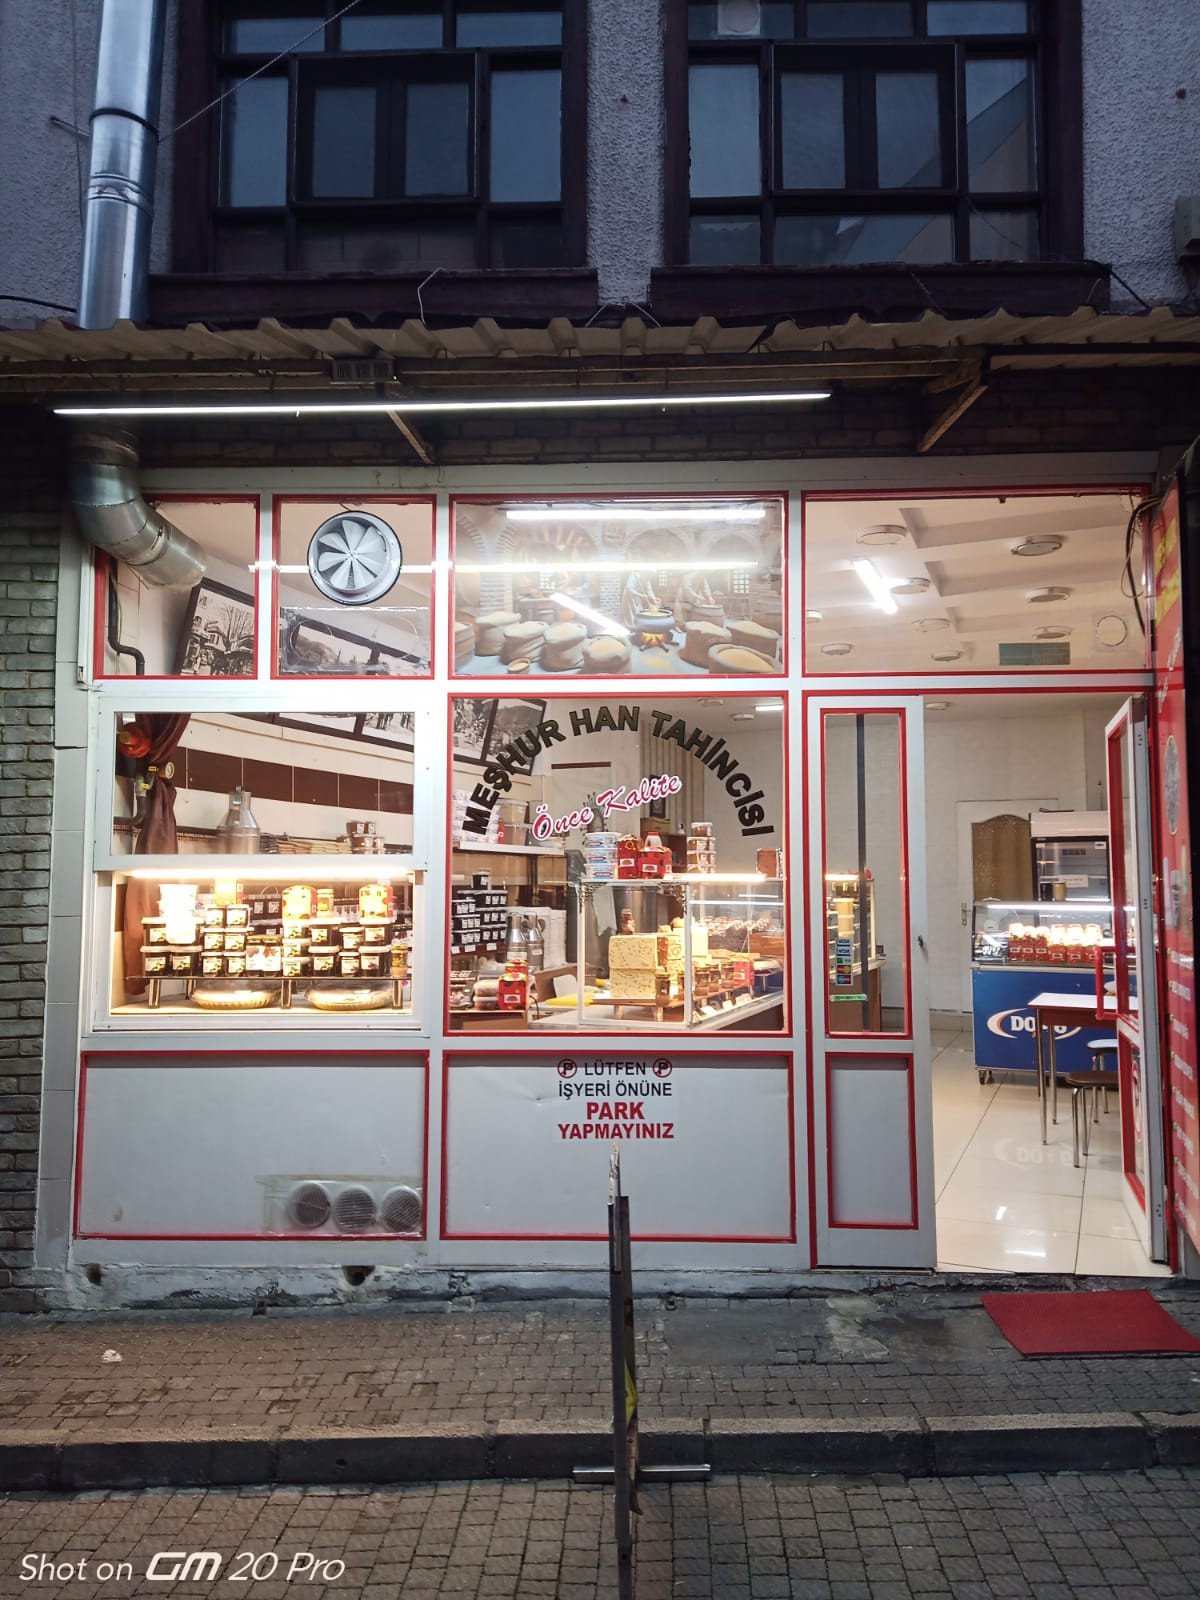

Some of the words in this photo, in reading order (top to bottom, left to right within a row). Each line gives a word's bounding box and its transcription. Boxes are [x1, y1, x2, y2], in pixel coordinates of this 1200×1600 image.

[462, 719, 566, 836] MEŞHUR
[569, 705, 640, 736] HAN
[532, 804, 594, 840] Önce
[596, 774, 683, 816] Kalite
[584, 1059, 646, 1076] LÜTFEN
[559, 1080, 610, 1100] İŞYERİ
[615, 1079, 672, 1097] ÖNÜNE
[586, 1101, 645, 1120] PARK
[558, 1123, 674, 1139] YAPMAYINIZ
